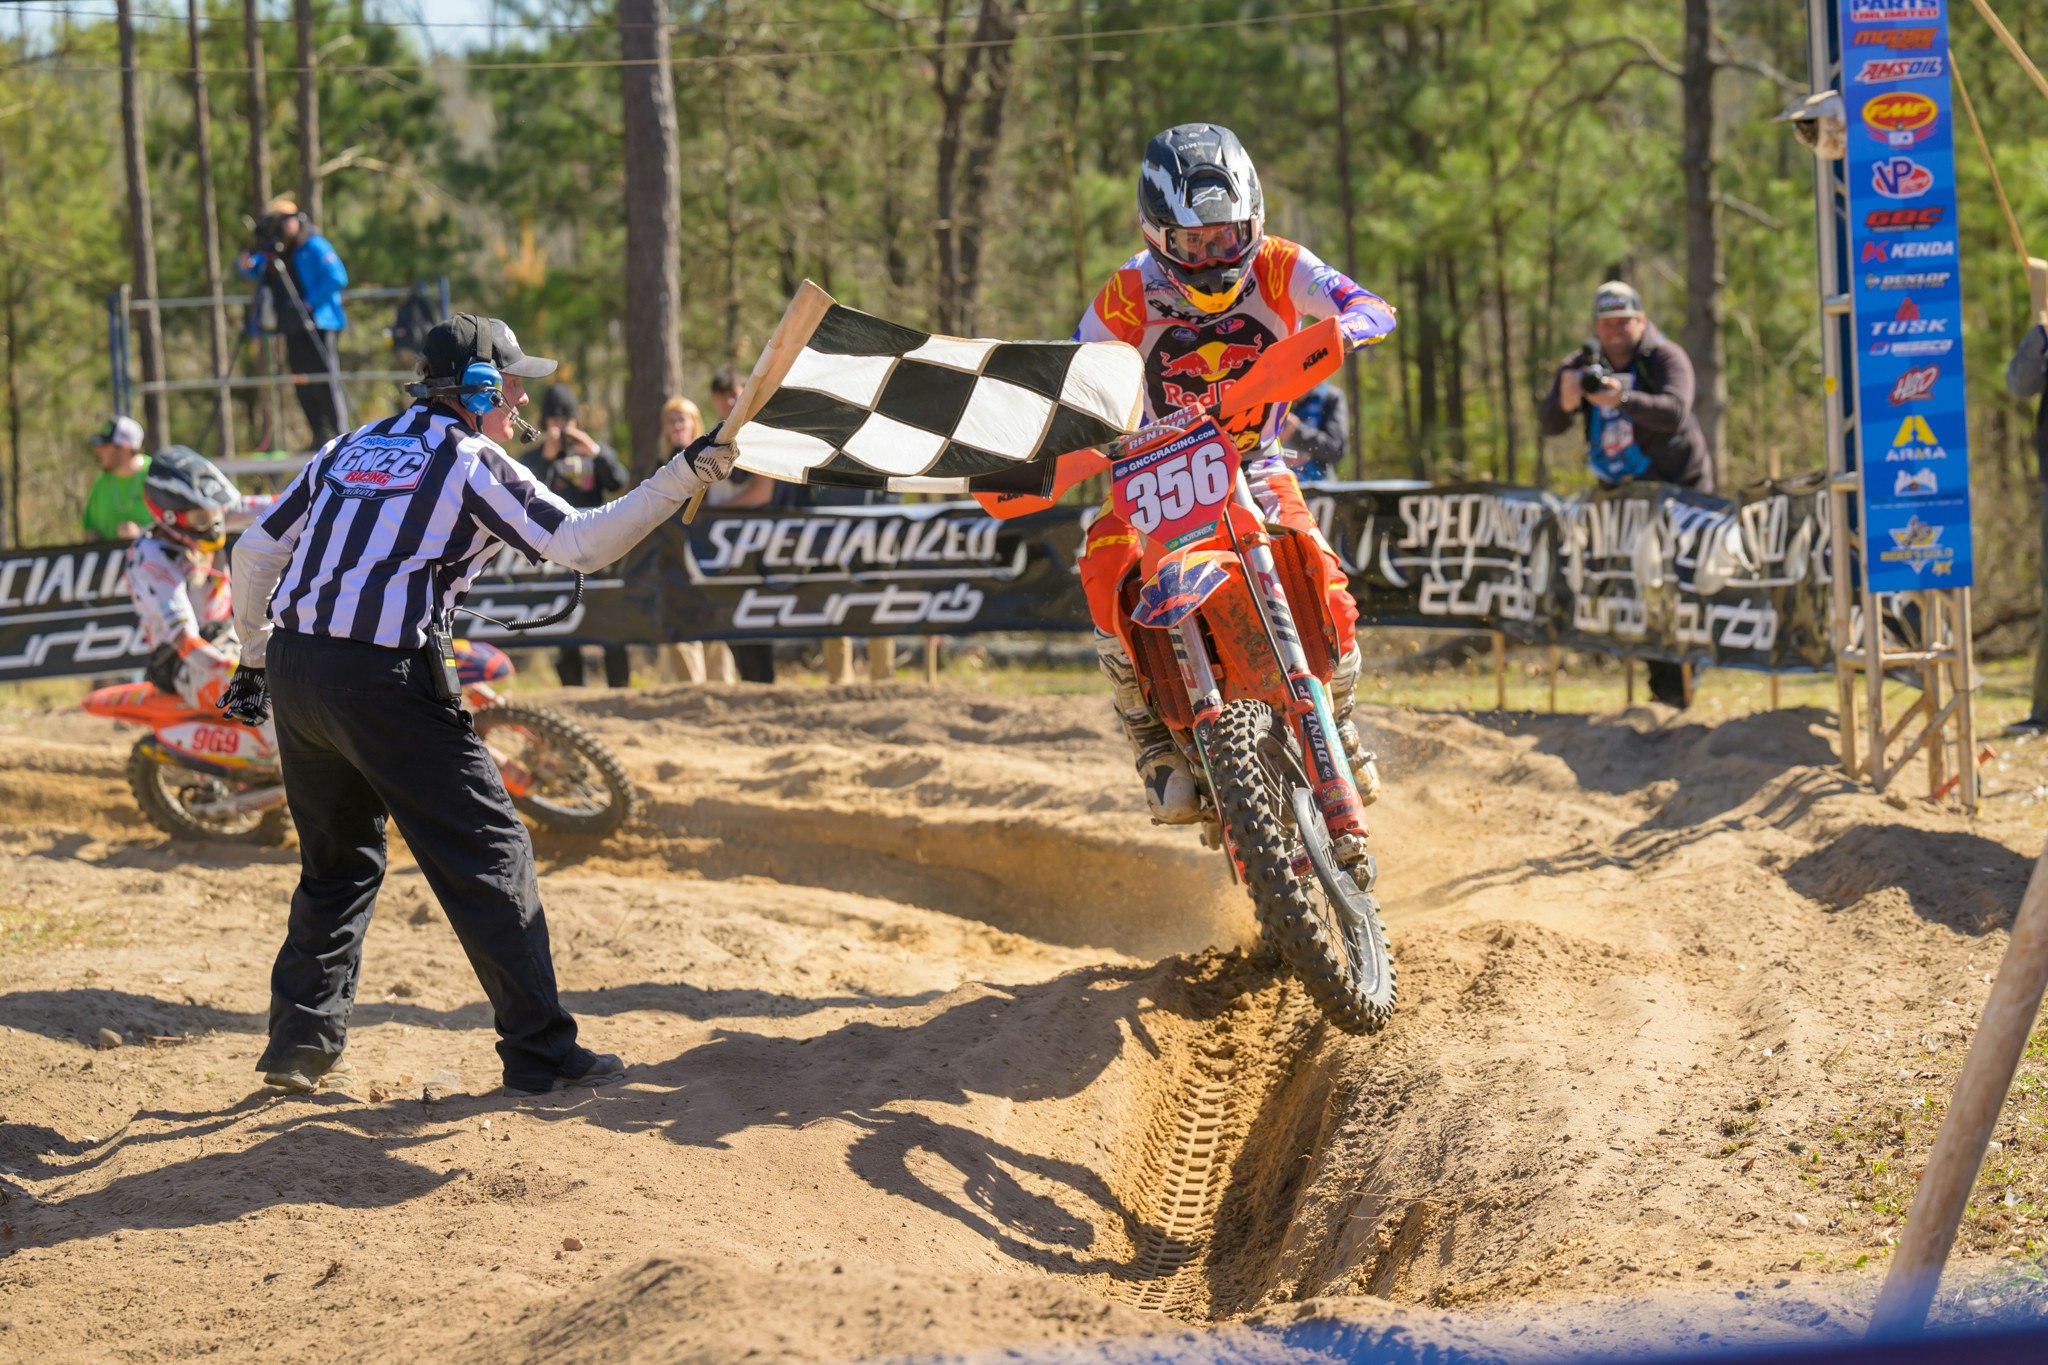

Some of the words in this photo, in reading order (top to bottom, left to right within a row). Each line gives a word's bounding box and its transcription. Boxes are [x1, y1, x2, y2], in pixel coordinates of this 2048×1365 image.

[1861, 59, 1941, 80] AMSOIL
[1868, 101, 1930, 119] FMF
[1875, 160, 1912, 195] VP
[1891, 241, 1954, 258] KENDA
[1880, 272, 1950, 291] DUNLOP
[1870, 318, 1949, 337] TUSK
[1302, 347, 1329, 371] KTM
[1162, 380, 1217, 409] Red
[333, 446, 426, 478] GNCC
[1128, 429, 1216, 472] GNCCRACING.COM
[1885, 446, 1947, 462] ARMA
[344, 470, 393, 487] RACING
[1126, 442, 1229, 536] 356
[701, 517, 1000, 569] SPECIALIZED
[1179, 524, 1213, 544] MOTOREX
[0, 549, 128, 609] CIALI
[733, 583, 984, 629] turbo
[1298, 685, 1330, 764] DUNLP
[192, 727, 239, 755] 969
